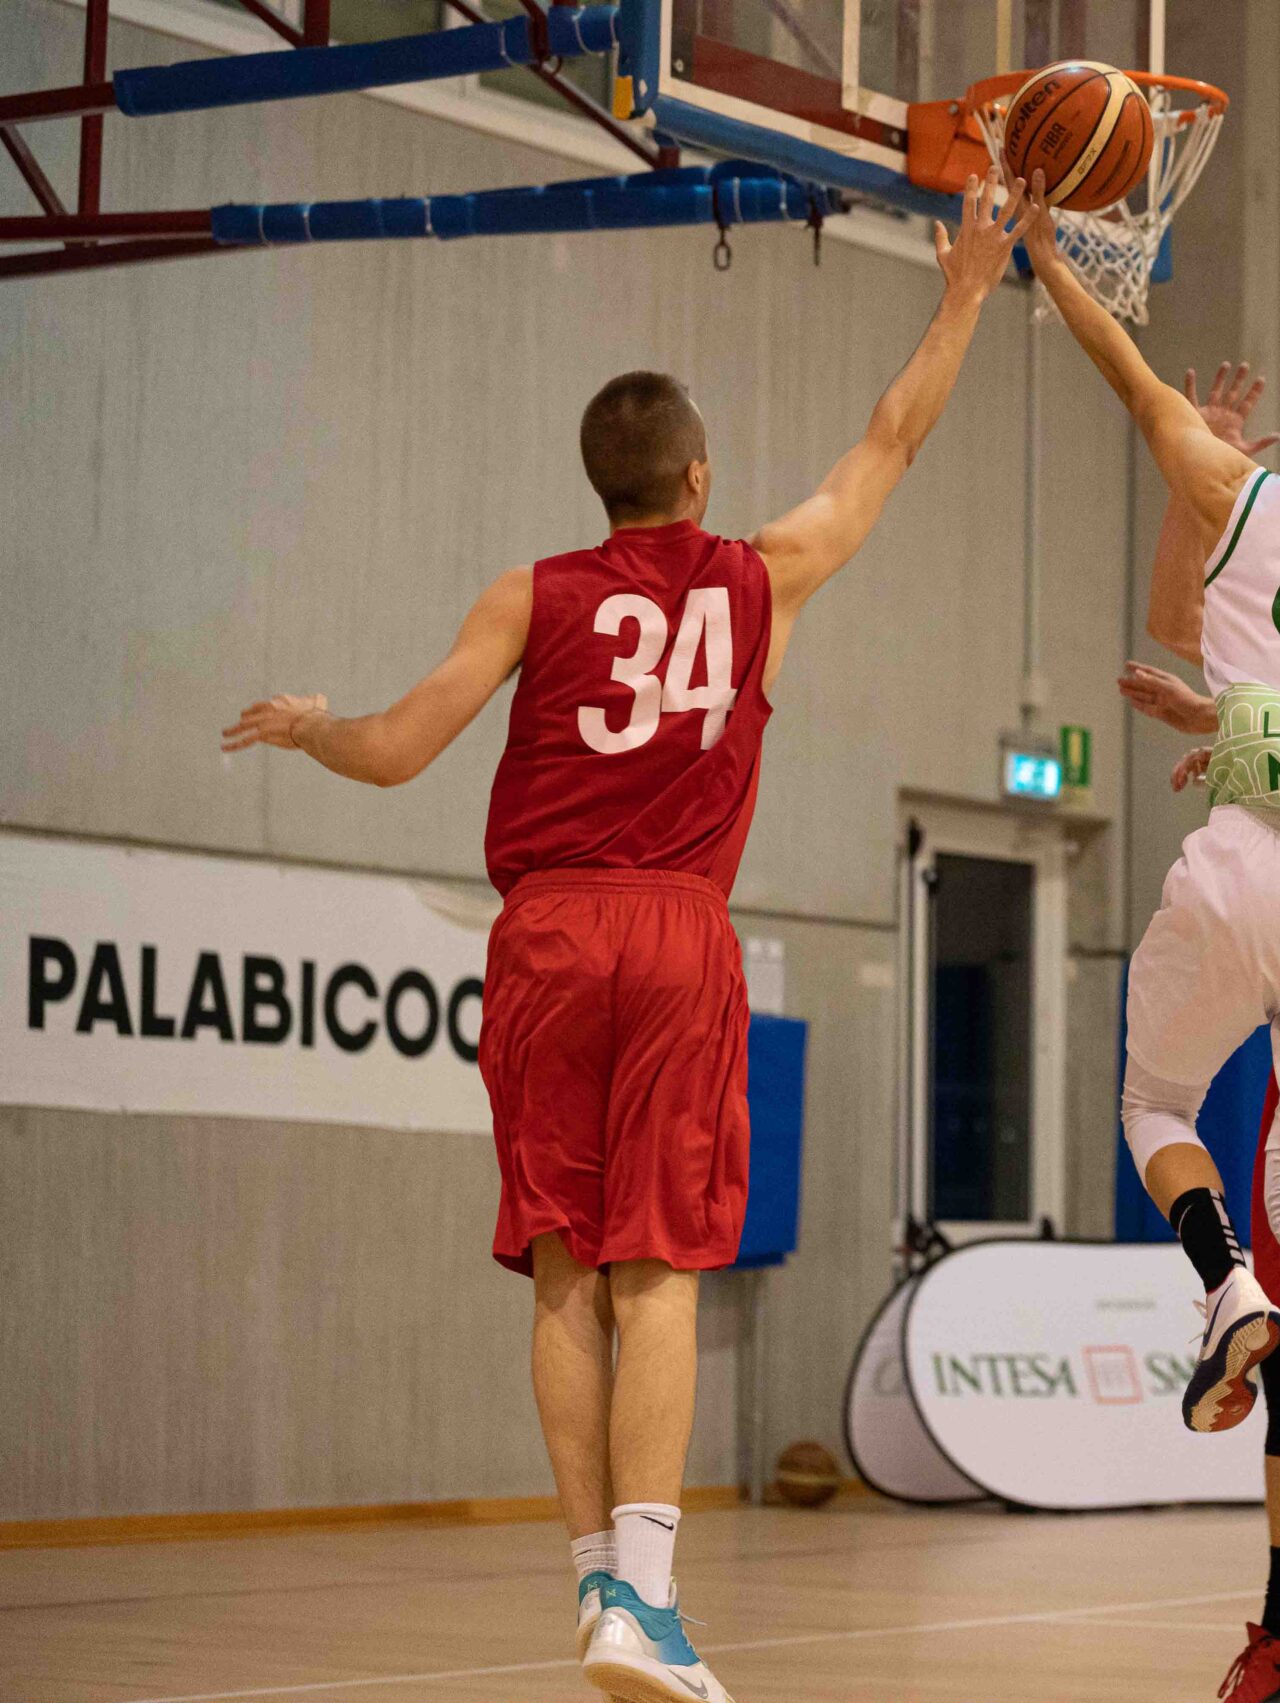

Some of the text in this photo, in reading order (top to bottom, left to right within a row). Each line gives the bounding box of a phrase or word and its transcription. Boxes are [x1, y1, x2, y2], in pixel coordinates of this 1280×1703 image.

[1009, 80, 1061, 157] molten
[1039, 121, 1067, 156] FIBA
[577, 586, 738, 755] 34
[932, 1351, 1077, 1397] INTESA
